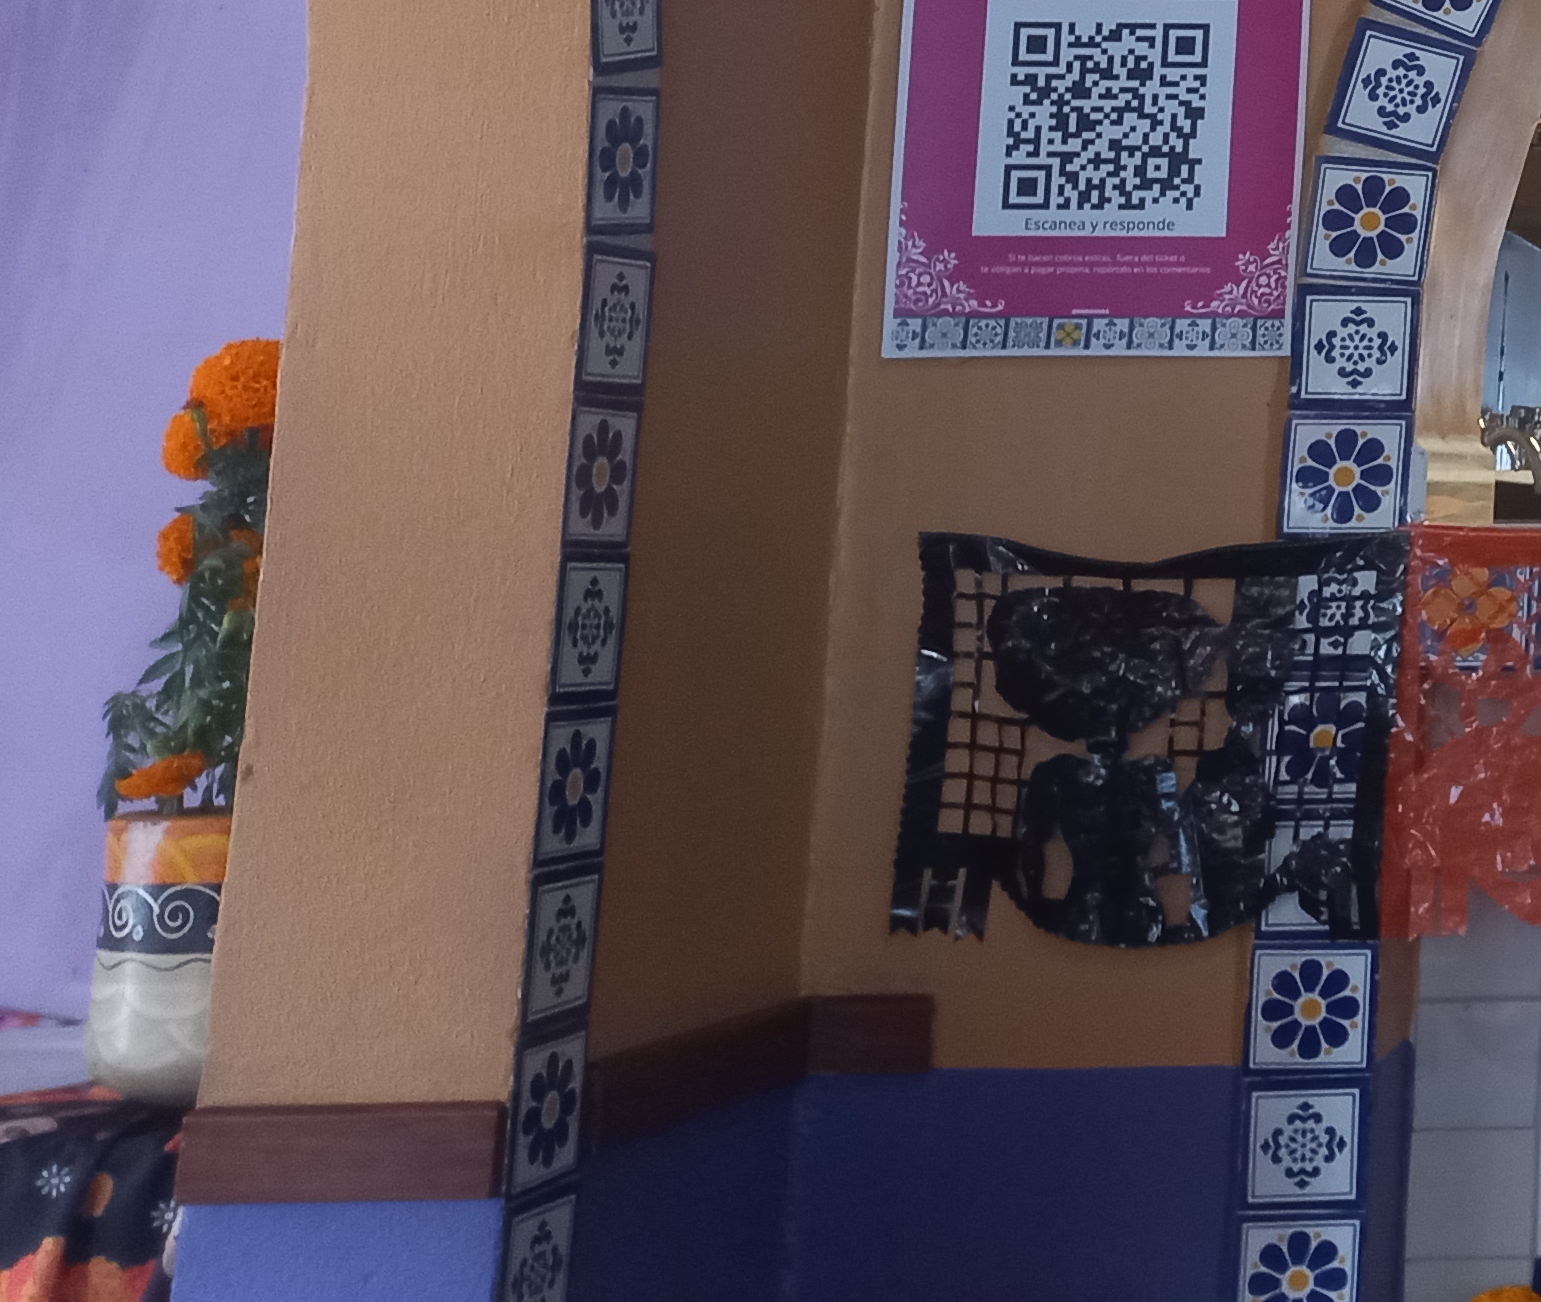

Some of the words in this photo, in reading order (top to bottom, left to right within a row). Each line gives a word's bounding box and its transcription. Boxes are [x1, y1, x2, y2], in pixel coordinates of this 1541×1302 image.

[1024, 217, 1086, 231] Escanea
[1089, 221, 1099, 235] y
[1102, 217, 1176, 235] responde
